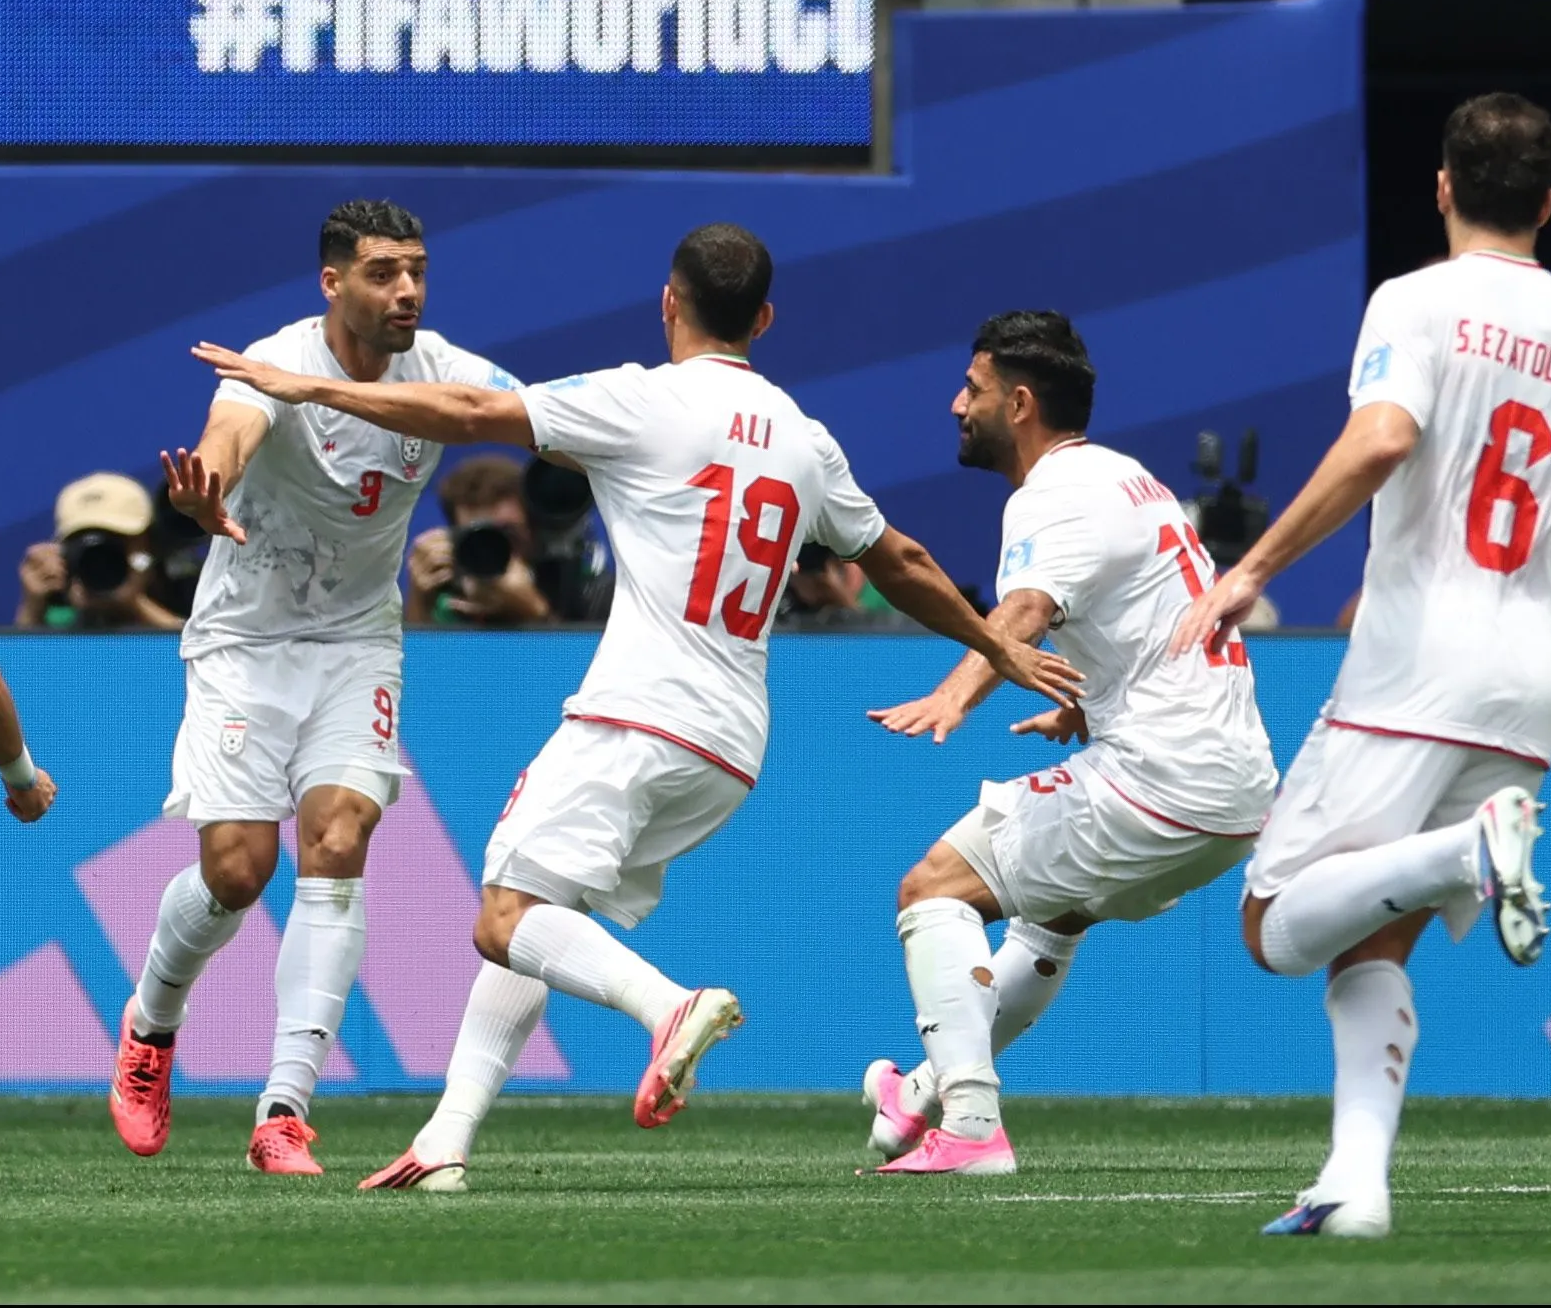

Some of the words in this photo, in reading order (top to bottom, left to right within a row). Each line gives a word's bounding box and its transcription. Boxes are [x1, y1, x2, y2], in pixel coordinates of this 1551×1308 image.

[728, 412, 772, 450] ALI
[351, 470, 384, 516] 9
[684, 462, 801, 641] 19
[371, 686, 394, 741] 9
